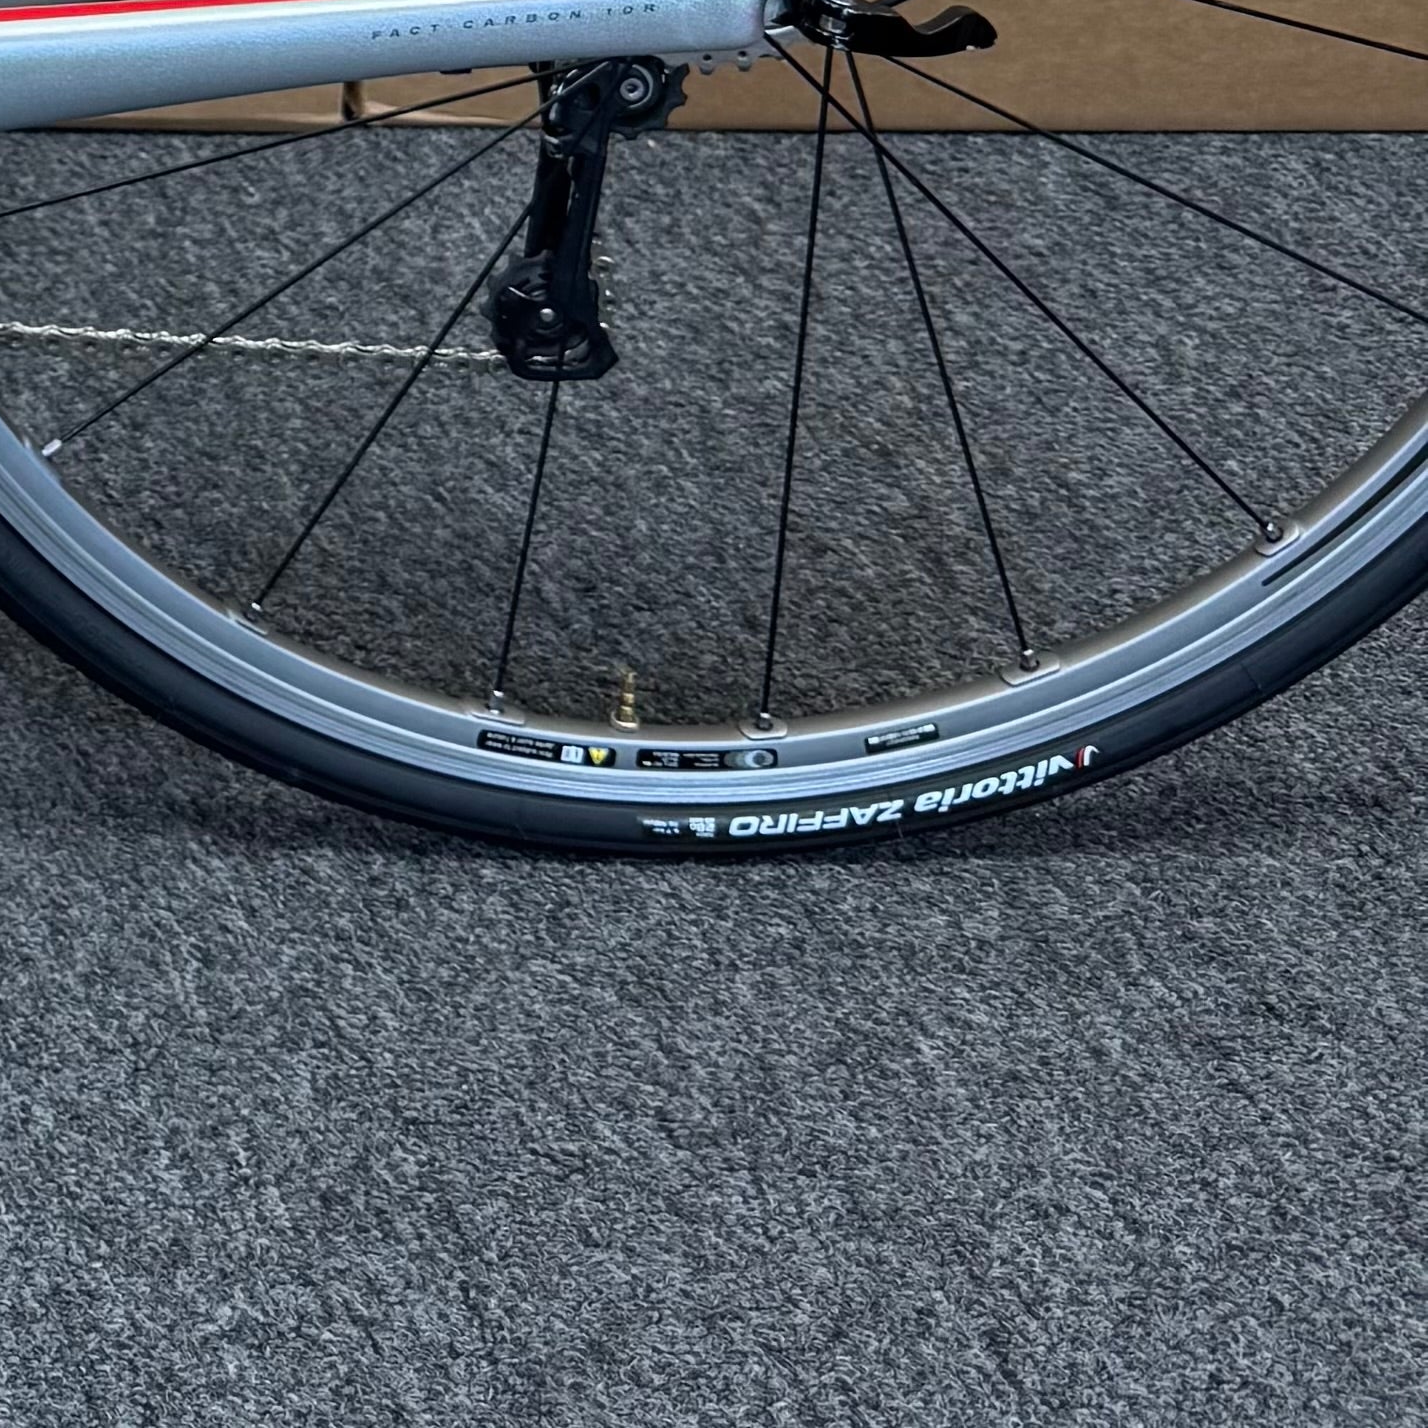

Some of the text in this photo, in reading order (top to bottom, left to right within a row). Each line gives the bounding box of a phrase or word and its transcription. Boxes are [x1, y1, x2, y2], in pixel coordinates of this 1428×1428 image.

[372, 23, 440, 40] FACT
[463, 9, 582, 30] CARBON
[728, 753, 1074, 837] vittoria ZAFFIRO
